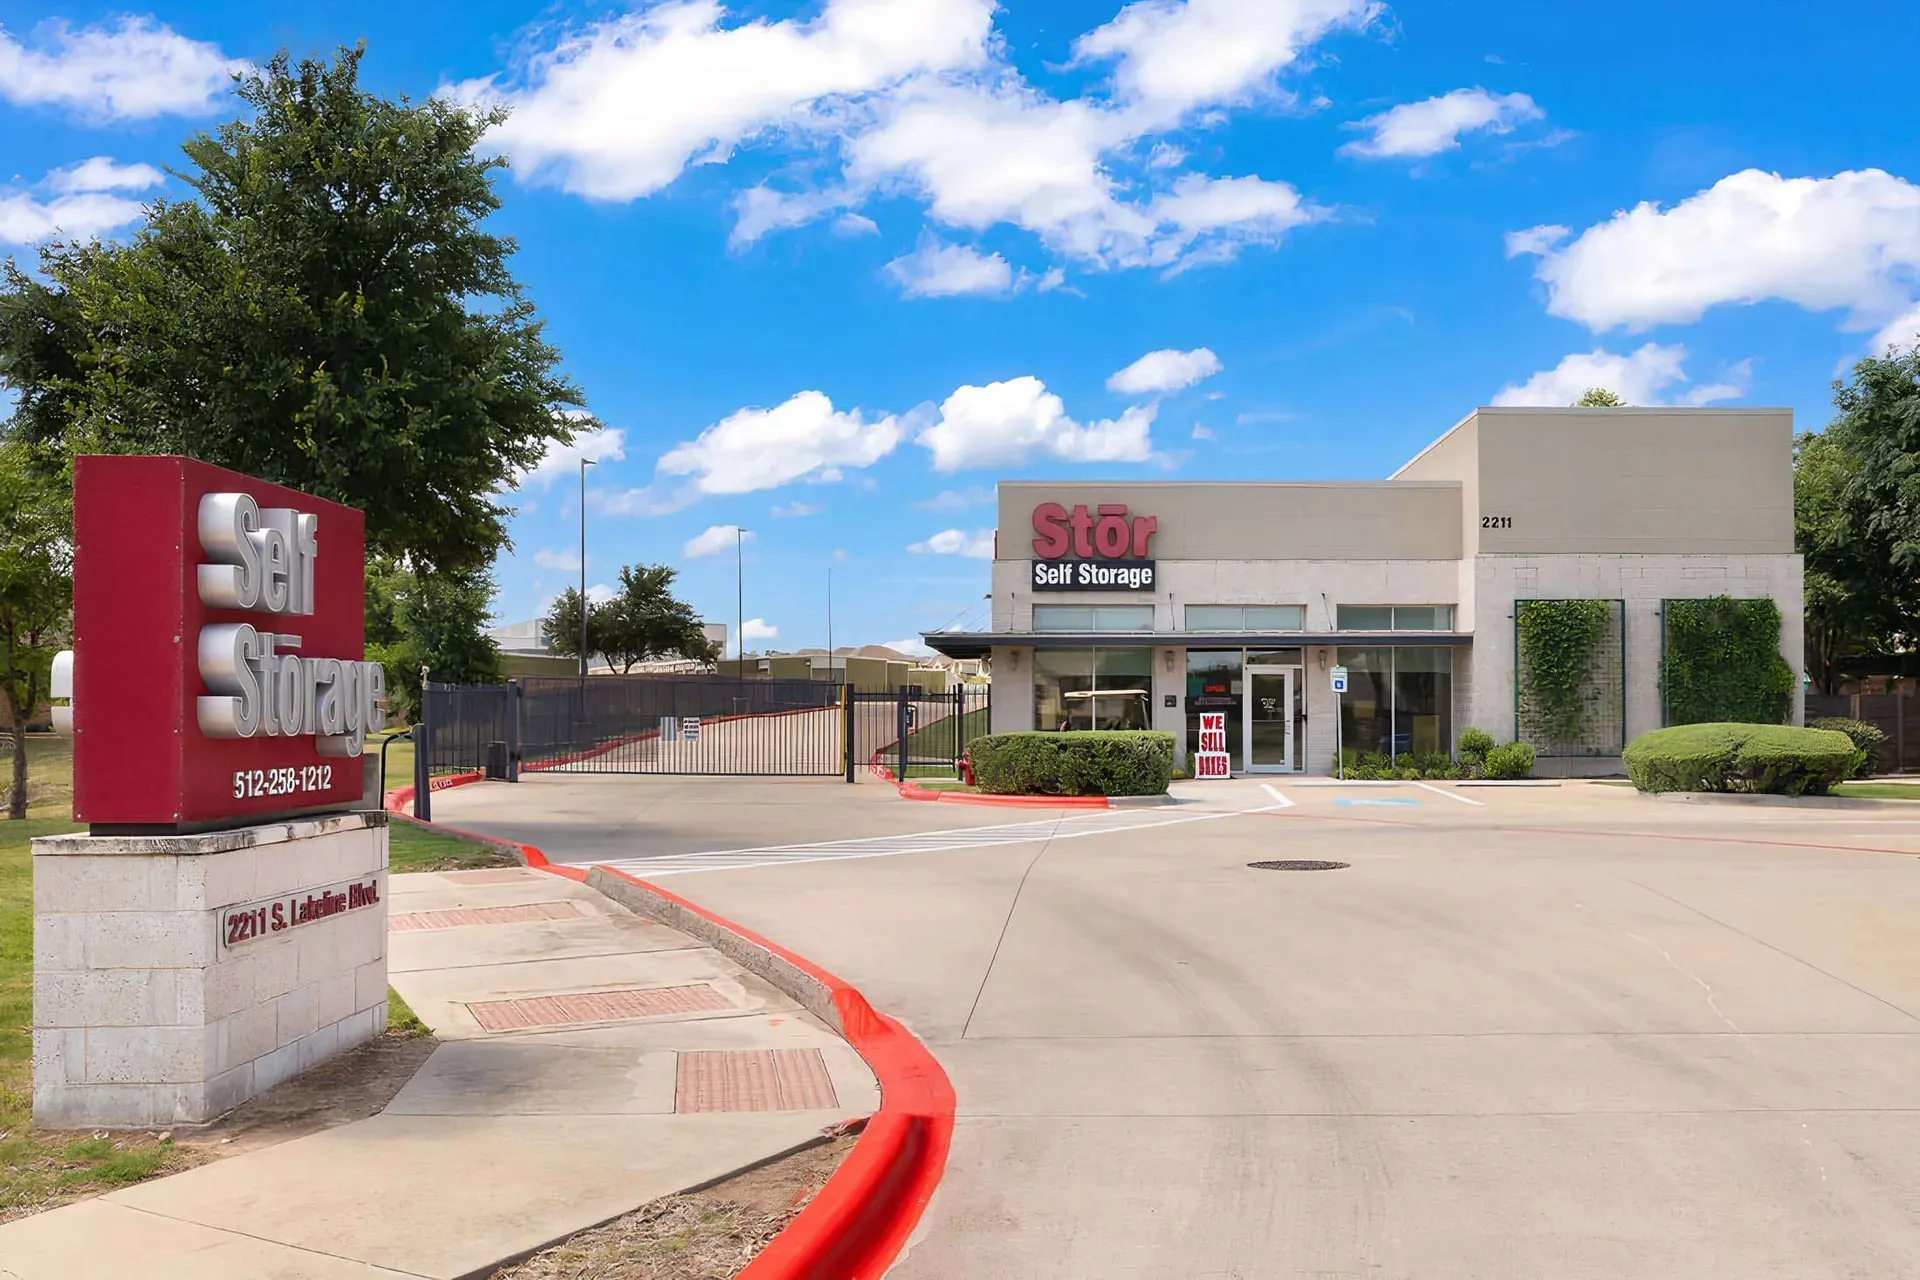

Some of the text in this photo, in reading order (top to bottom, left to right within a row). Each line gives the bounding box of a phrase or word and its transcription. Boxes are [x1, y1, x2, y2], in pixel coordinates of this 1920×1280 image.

[1032, 502, 1157, 559] Stōr
[1482, 516, 1512, 528] 2211
[197, 493, 317, 616] Self
[1035, 563, 1153, 589] Self Storage
[1202, 715, 1223, 730] WE
[1200, 732, 1224, 752] SELL
[233, 765, 332, 798] 512-258-1212
[227, 907, 267, 944] 2211
[271, 902, 288, 931] S.
